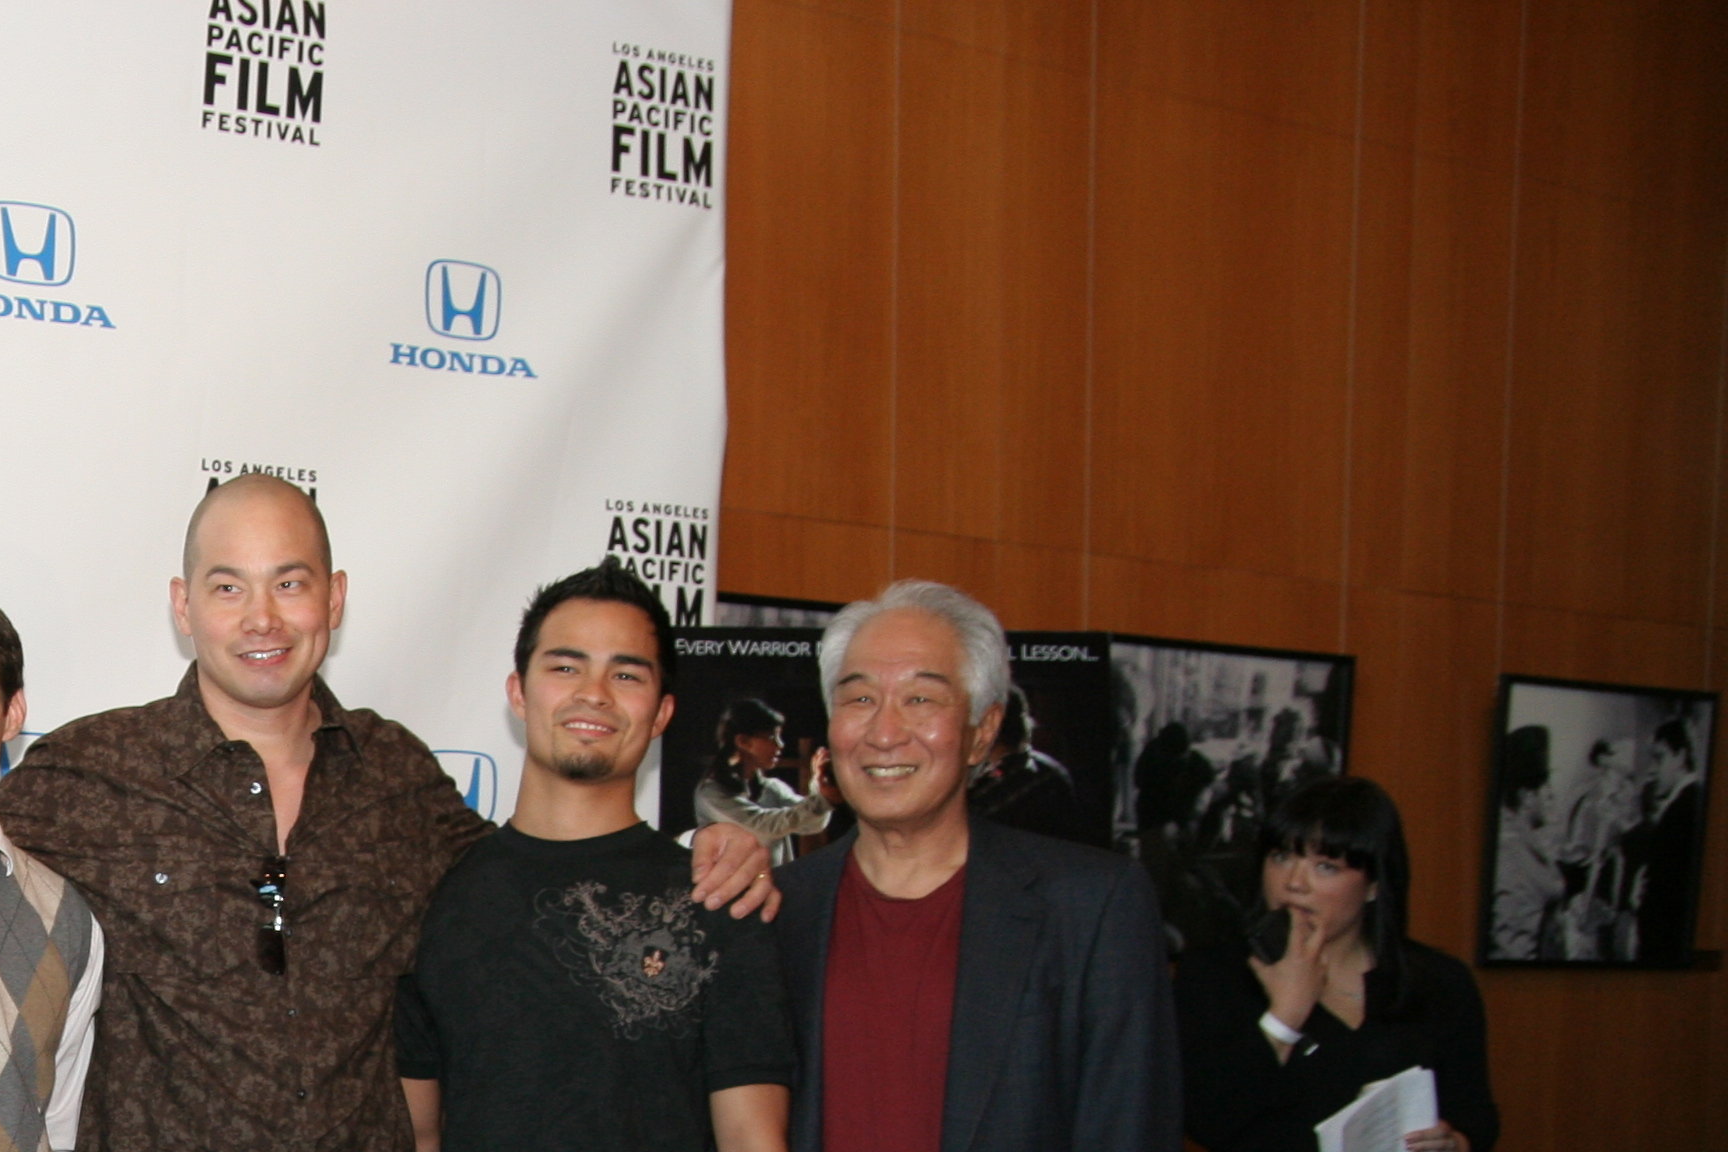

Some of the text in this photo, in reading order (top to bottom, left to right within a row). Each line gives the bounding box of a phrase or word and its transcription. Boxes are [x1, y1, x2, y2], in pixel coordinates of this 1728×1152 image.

[206, 23, 324, 66] PACIFIC
[612, 41, 715, 72] LOS ANGELES
[203, 51, 324, 123] FILM
[613, 59, 715, 112] ASIAN
[201, 110, 320, 146] FESTIVAL
[612, 98, 713, 136] PACIFIC
[611, 123, 713, 188] FILM
[610, 177, 712, 210] FESTIVAL
[389, 342, 539, 379] HONDA
[201, 458, 233, 474] LOS
[605, 499, 709, 520] LOS ANGELES
[607, 515, 708, 560] ASIAN
[613, 555, 705, 585] ACIFIC
[674, 638, 726, 657] EVERY
[727, 639, 812, 658] WARRIOR
